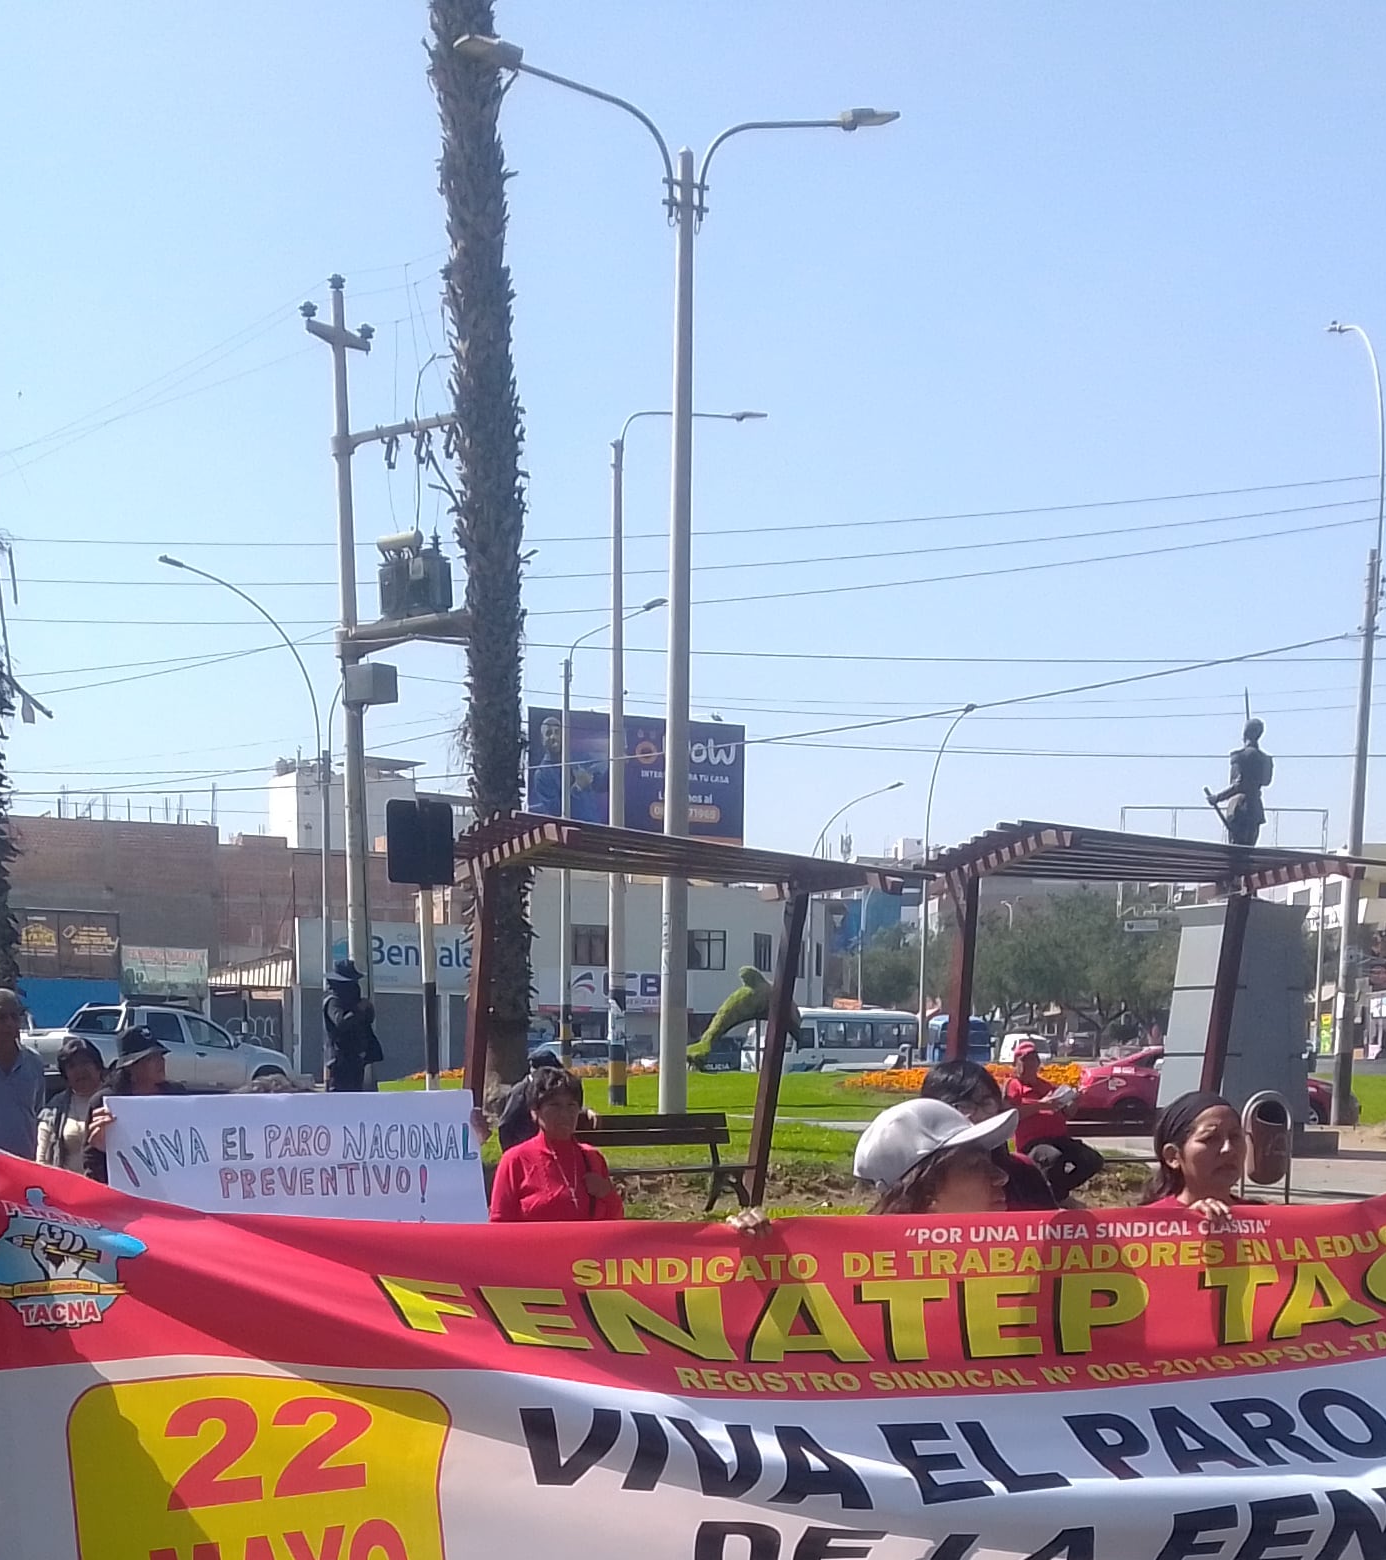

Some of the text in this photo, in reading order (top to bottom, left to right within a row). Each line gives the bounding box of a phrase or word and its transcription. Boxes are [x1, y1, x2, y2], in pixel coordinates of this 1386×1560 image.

[220, 1126, 255, 1162] EL
[263, 1123, 332, 1159] PARO
[341, 1120, 479, 1162] NACIONAL
[970, 1226, 1017, 1243] UNA
[1025, 1219, 1090, 1241] LÍNEA
[1095, 1220, 1192, 1239] SINDICAL
[572, 1253, 819, 1286] SINDICATO
[842, 1250, 900, 1279] DE
[907, 1239, 1225, 1276] TRABAJADORES
[1235, 1238, 1272, 1263] EN
[1276, 1237, 1314, 1261] LA
[19, 1299, 103, 1327] TACNA
[376, 1271, 1150, 1364] FENATEP
[675, 1366, 862, 1393] REGISTRO
[874, 1364, 1037, 1393] SINDICAL
[163, 1395, 373, 1512] 22
[519, 1407, 875, 1511] VIVA
[876, 1420, 1074, 1506] EL
